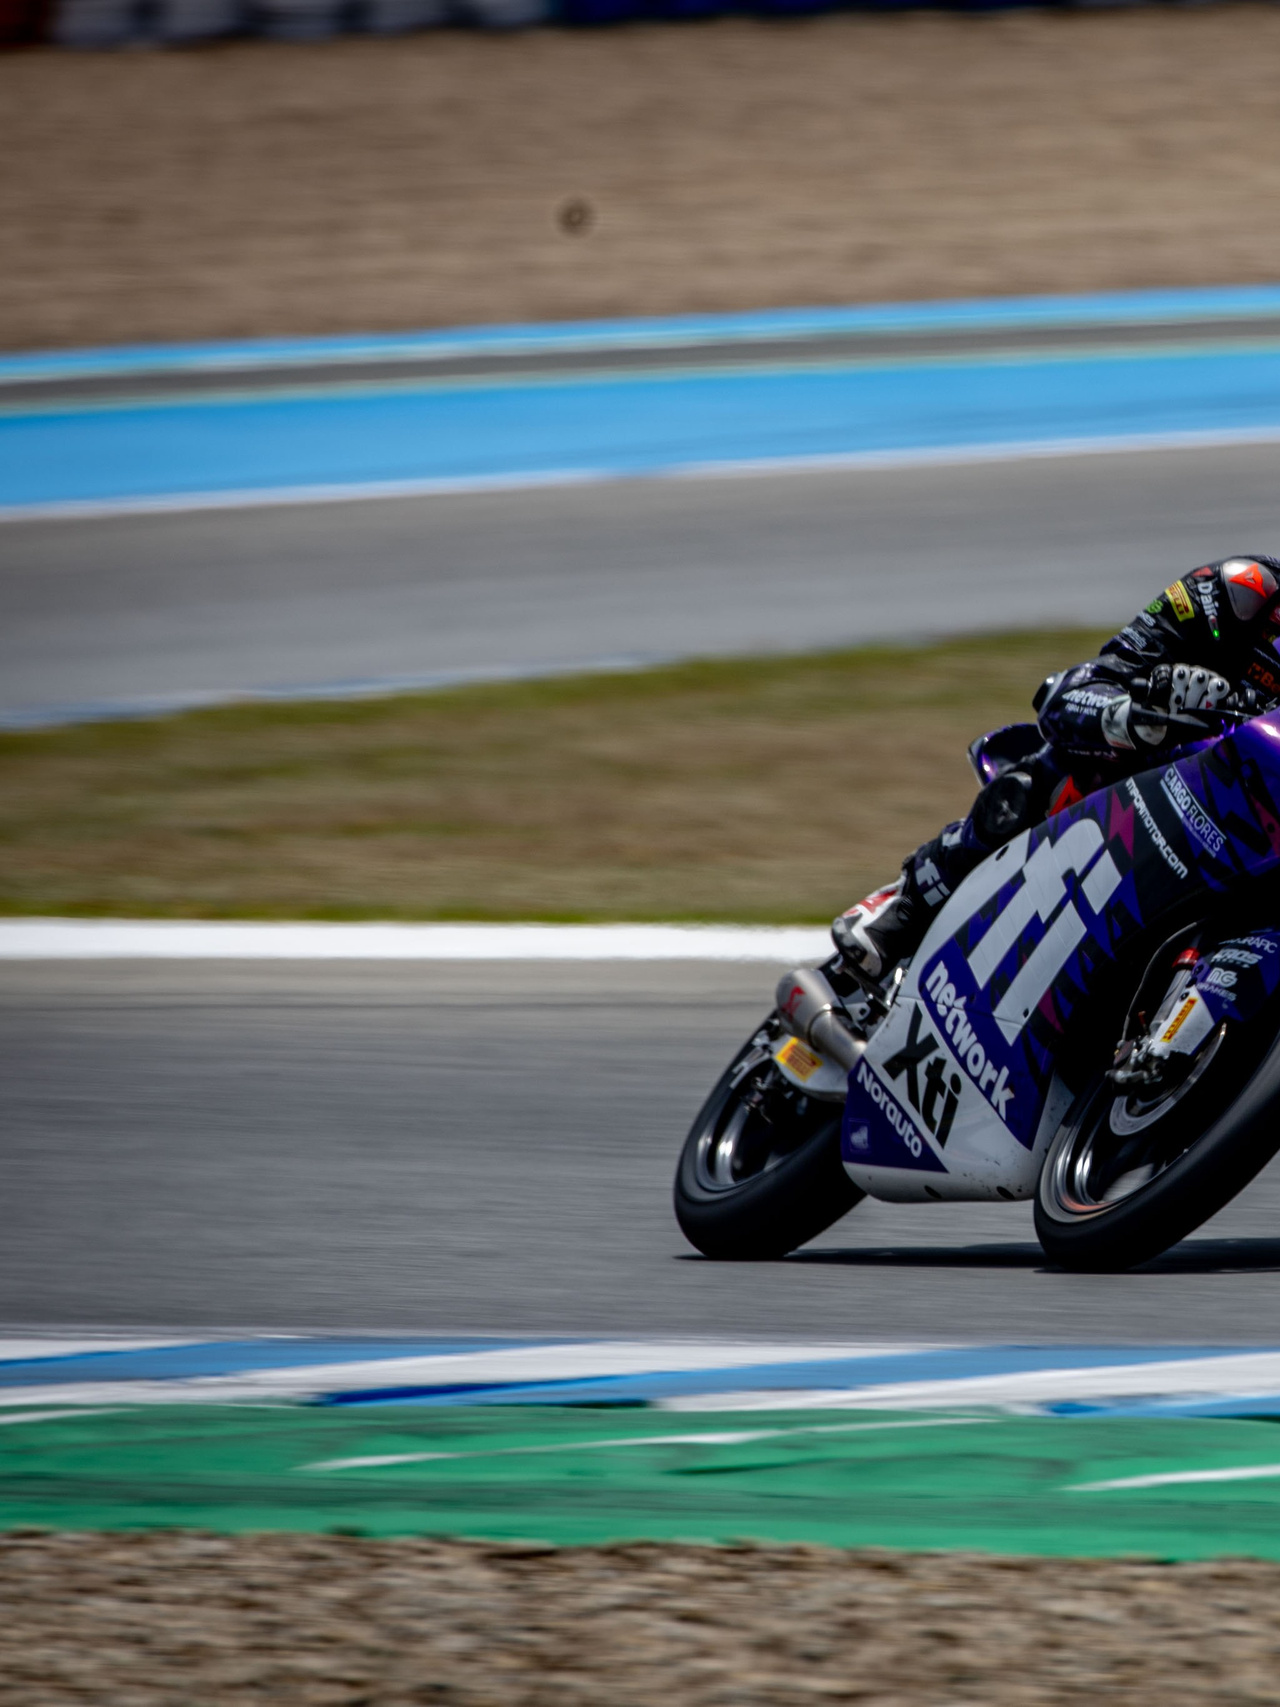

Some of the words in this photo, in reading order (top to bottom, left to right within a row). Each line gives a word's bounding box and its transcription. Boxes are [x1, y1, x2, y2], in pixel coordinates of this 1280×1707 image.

[857, 1062, 923, 1158] Norauto
[882, 1001, 962, 1149] Xti
[925, 960, 1015, 1120] network
